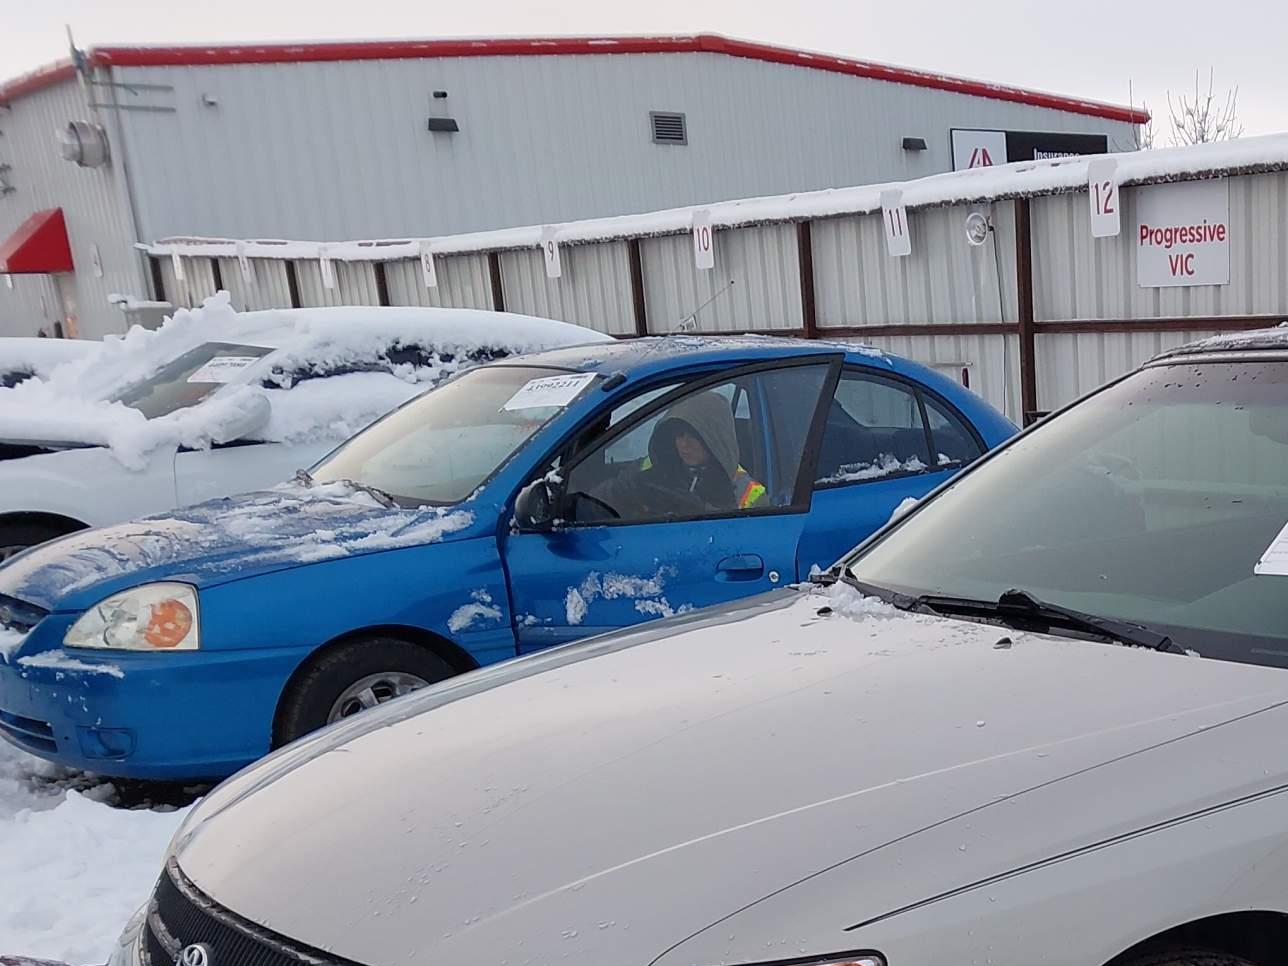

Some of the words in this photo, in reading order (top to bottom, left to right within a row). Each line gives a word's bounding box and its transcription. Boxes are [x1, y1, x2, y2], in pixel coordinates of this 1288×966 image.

[1093, 180, 1115, 216] 12
[887, 208, 903, 238] 11
[1139, 220, 1227, 248] Progressive
[547, 240, 555, 262] 9
[696, 226, 710, 252] 10
[1168, 254, 1196, 277] VIC
